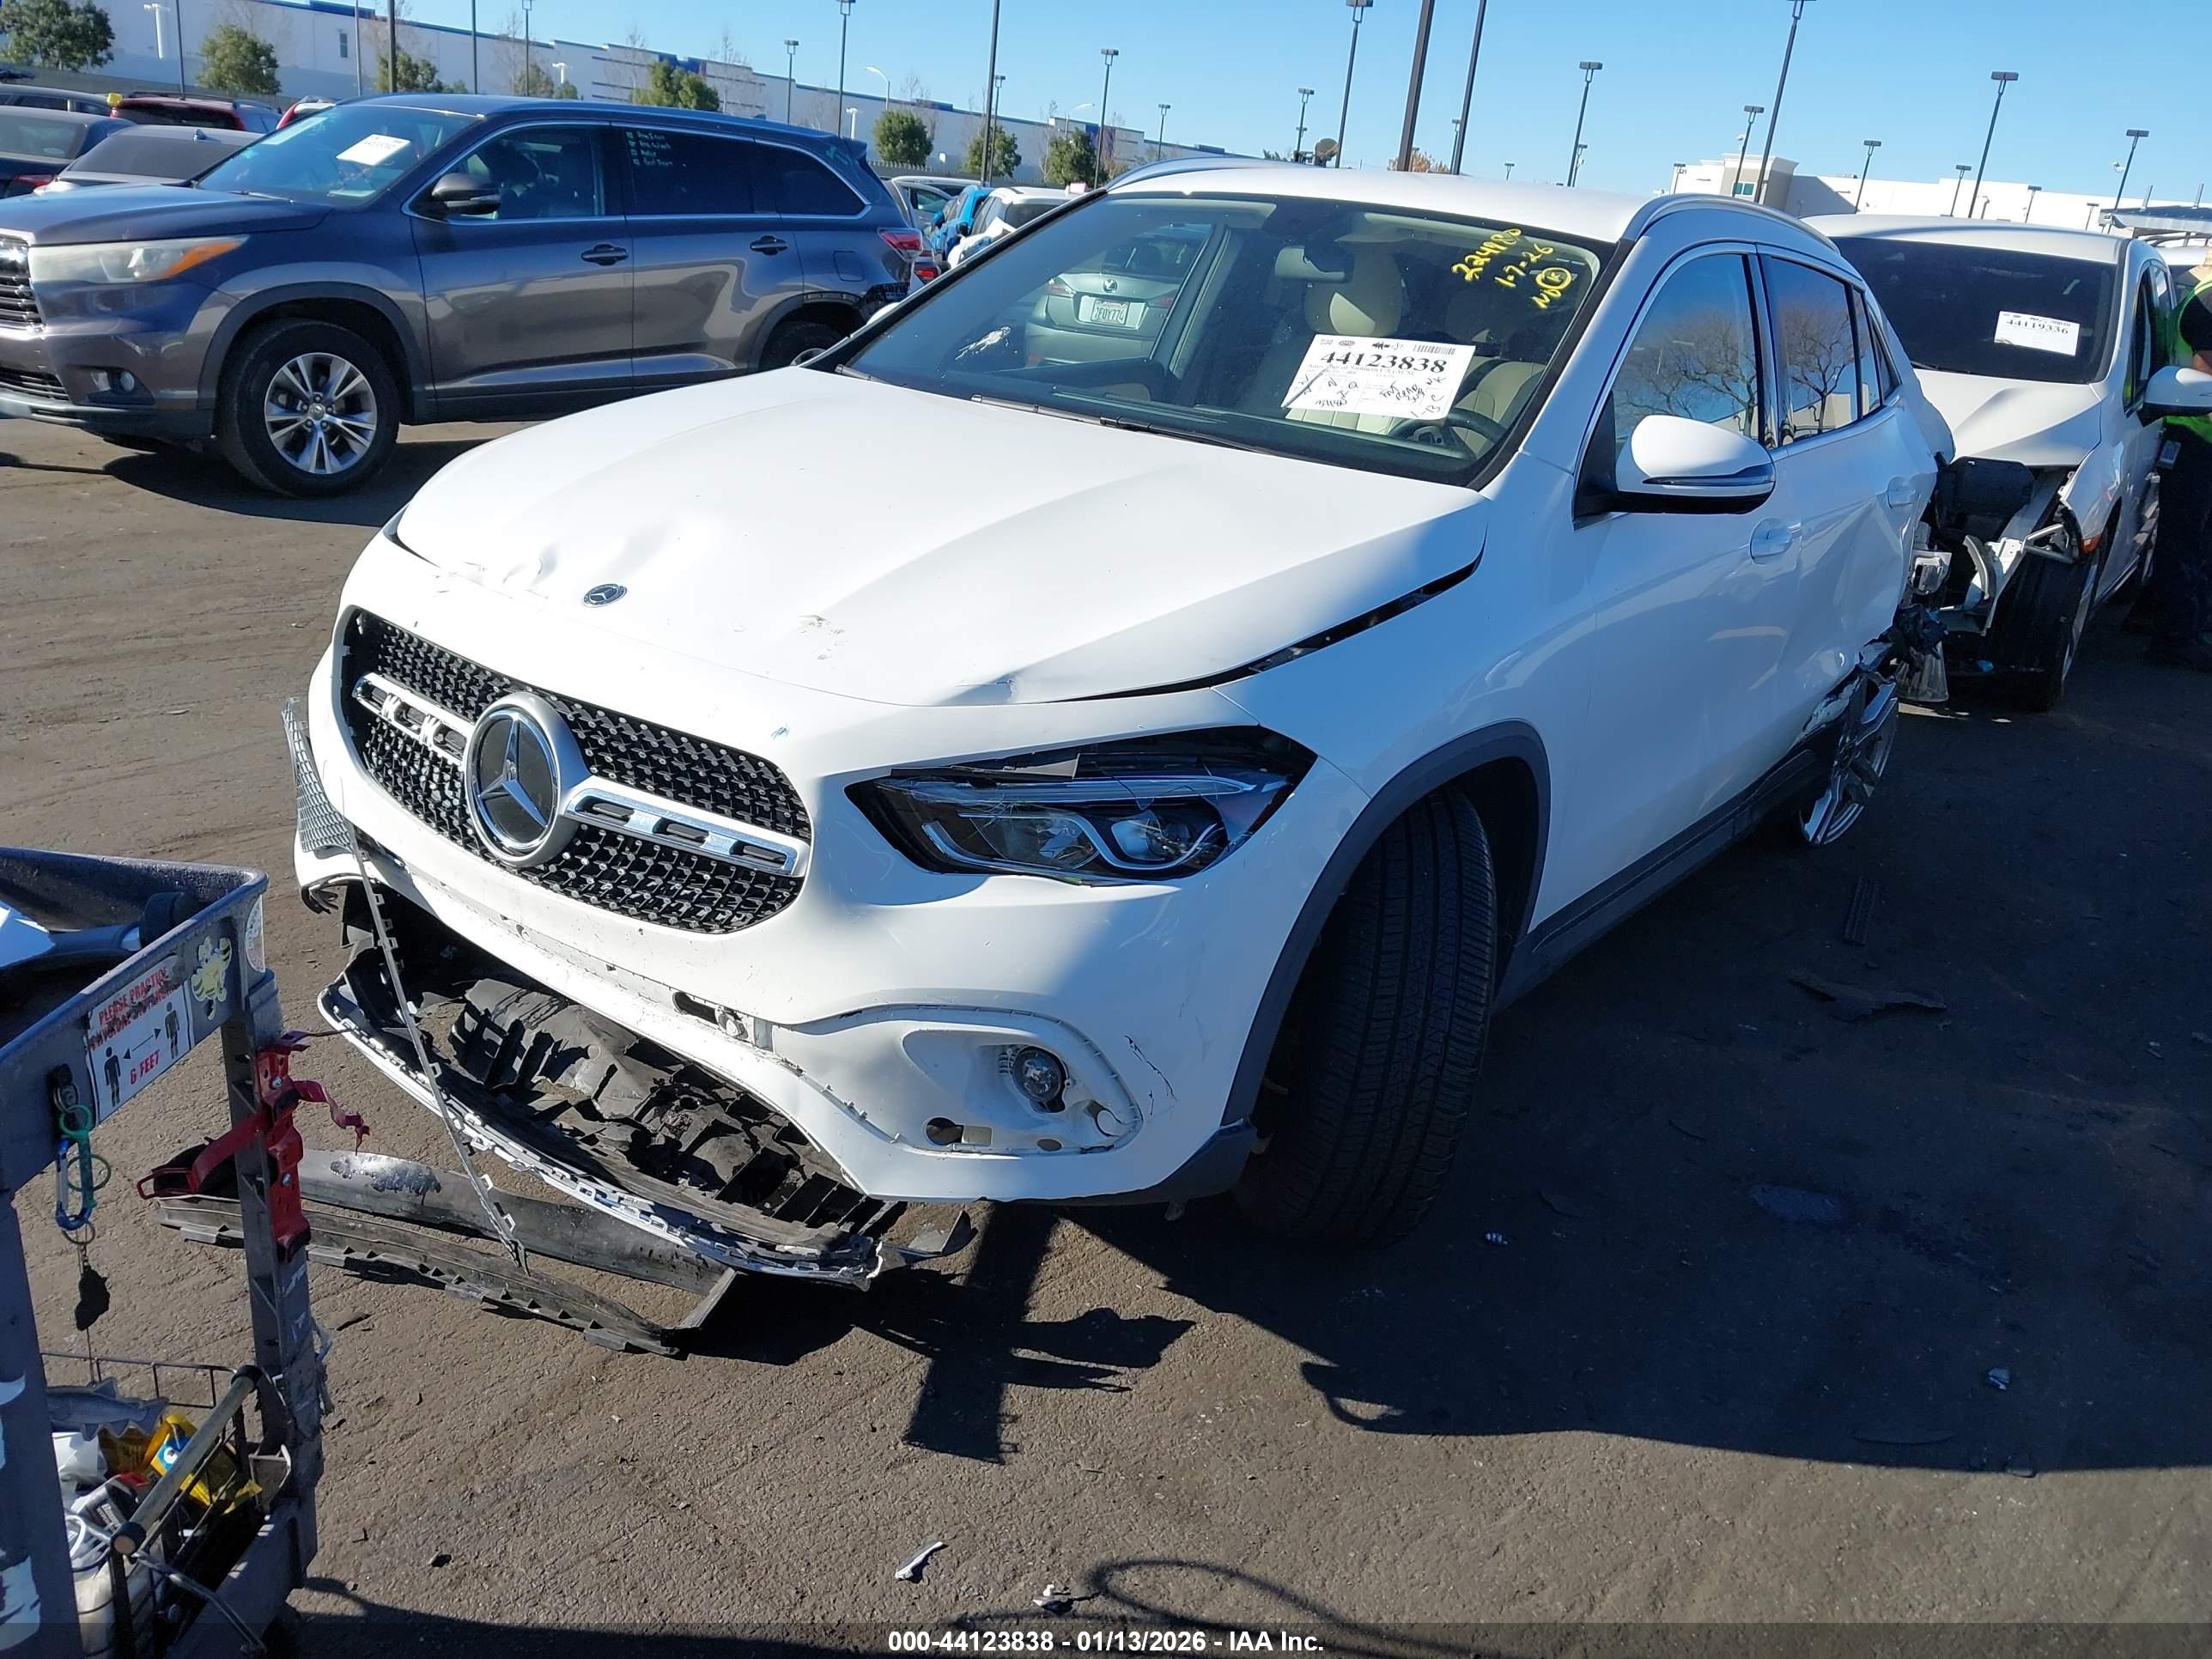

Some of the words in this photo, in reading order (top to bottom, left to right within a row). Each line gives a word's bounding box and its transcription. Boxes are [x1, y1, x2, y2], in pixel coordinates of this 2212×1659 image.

[2006, 319, 2069, 335] 44119336
[1321, 351, 1447, 374] 44123838
[99, 994, 129, 1025] PLEASE
[139, 1048, 160, 1079] FEET
